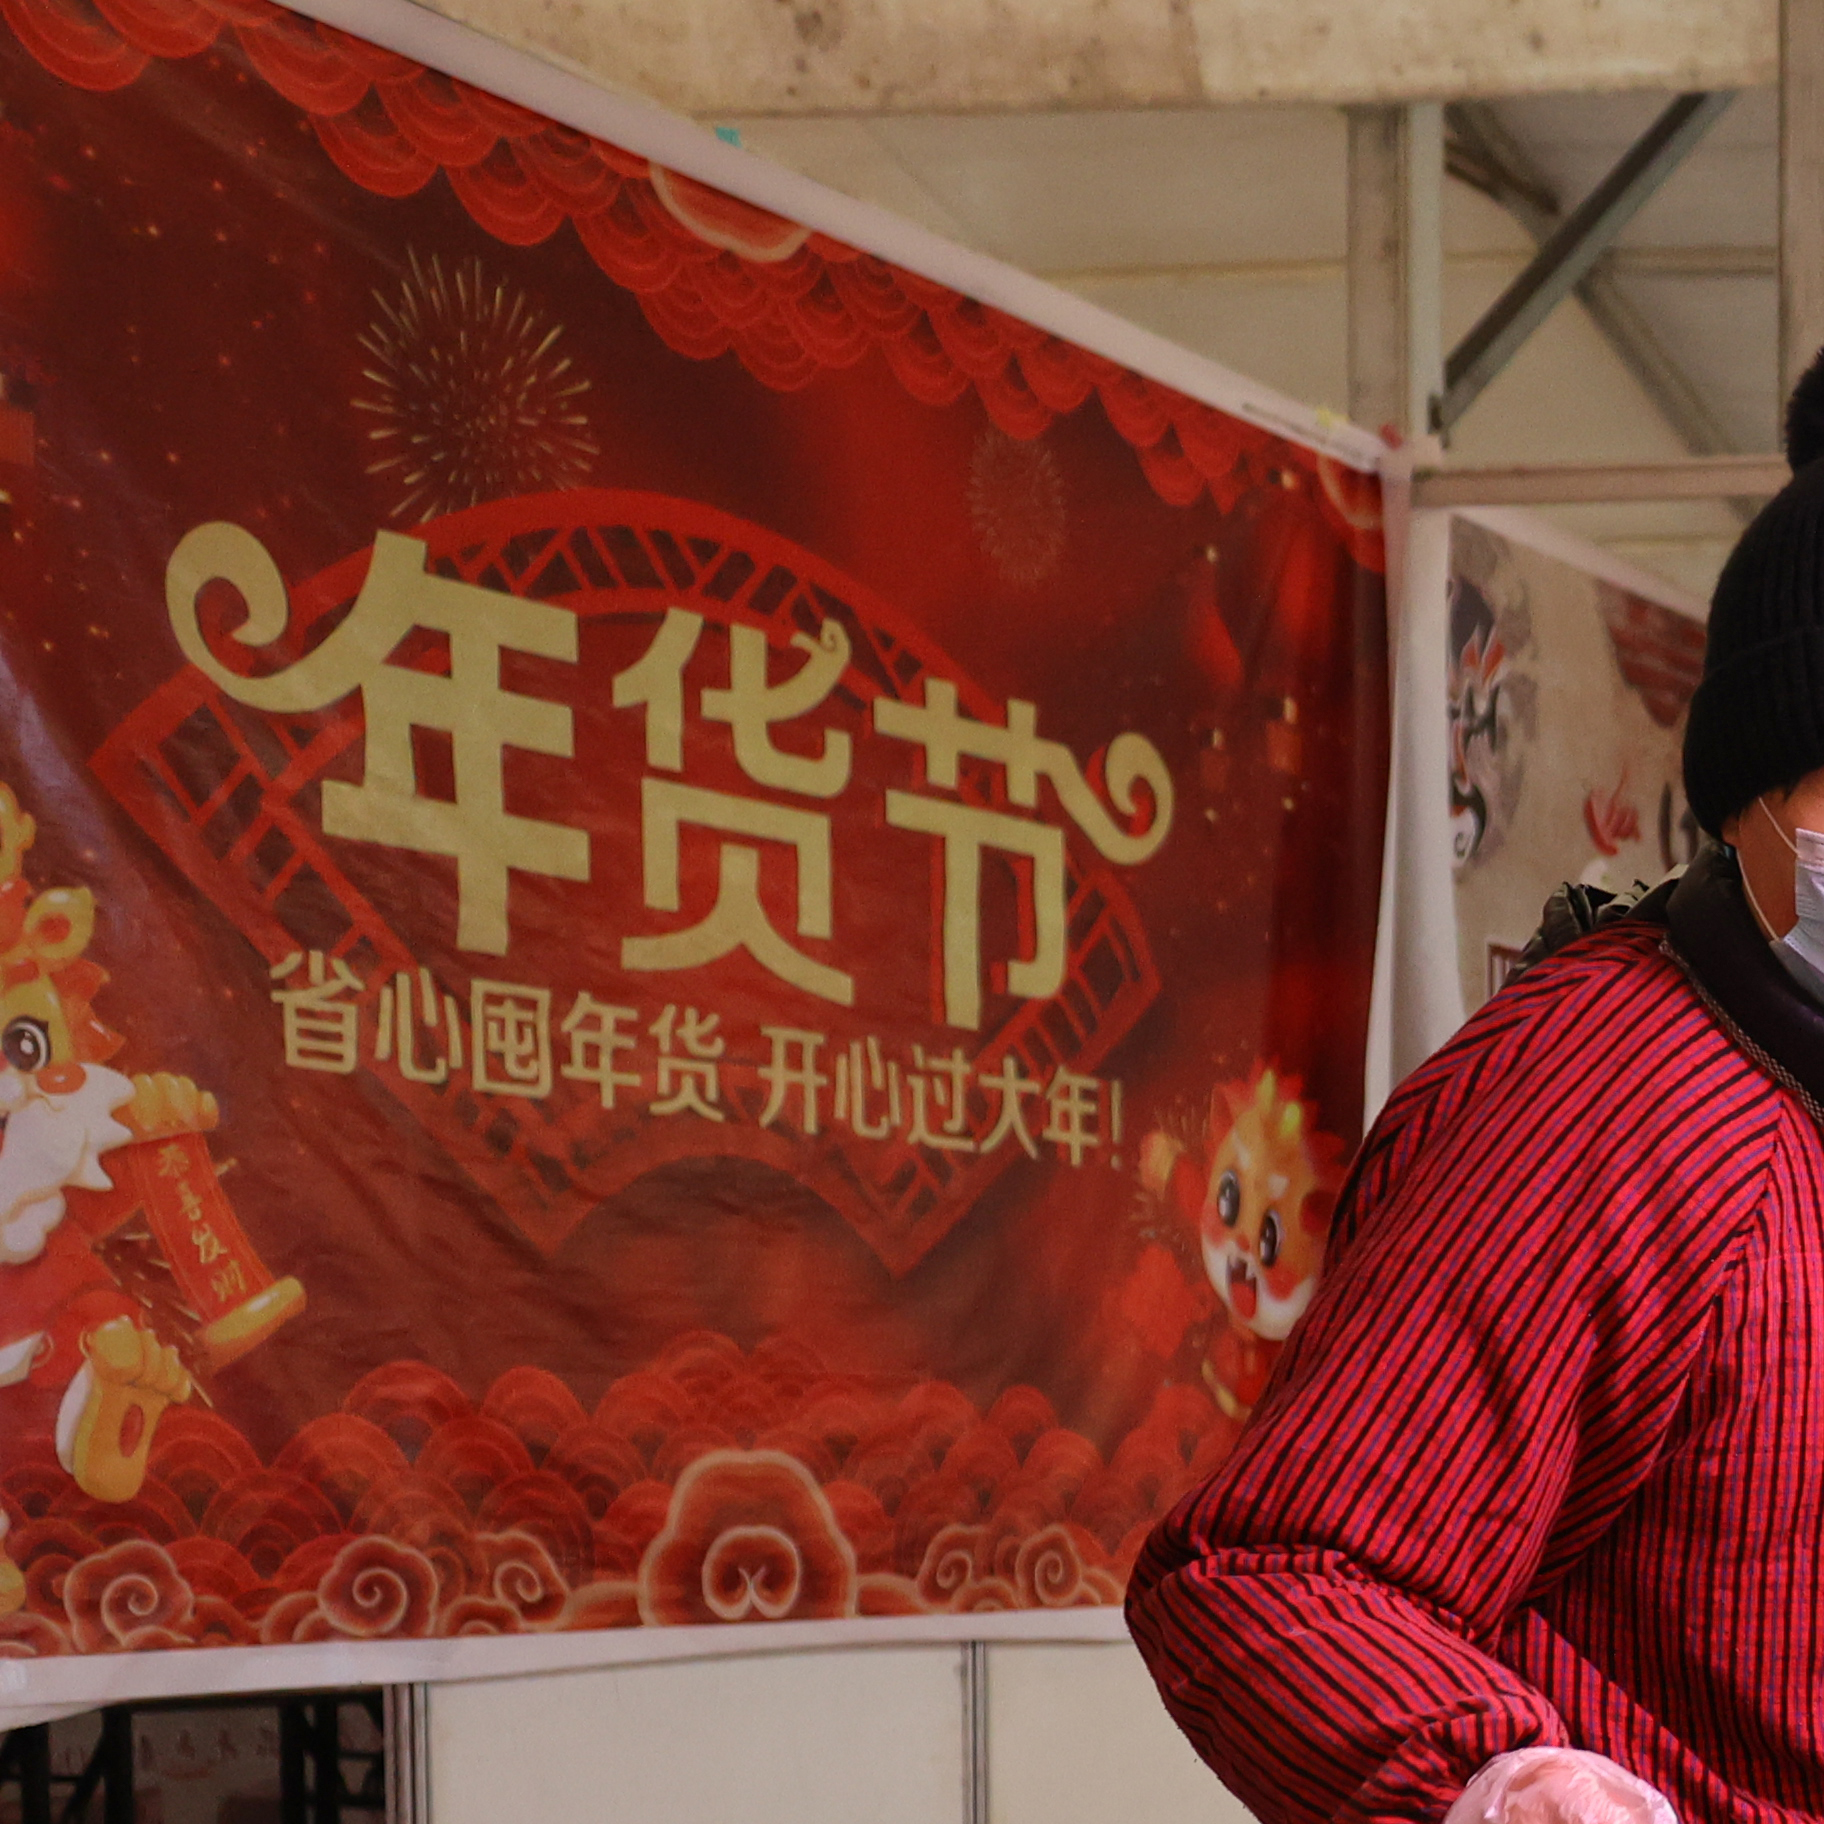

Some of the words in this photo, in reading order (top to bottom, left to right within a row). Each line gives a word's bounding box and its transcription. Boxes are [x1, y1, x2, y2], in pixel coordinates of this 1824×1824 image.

[165, 520, 1175, 1032] 年货节
[269, 948, 728, 1124] 省心囤年货
